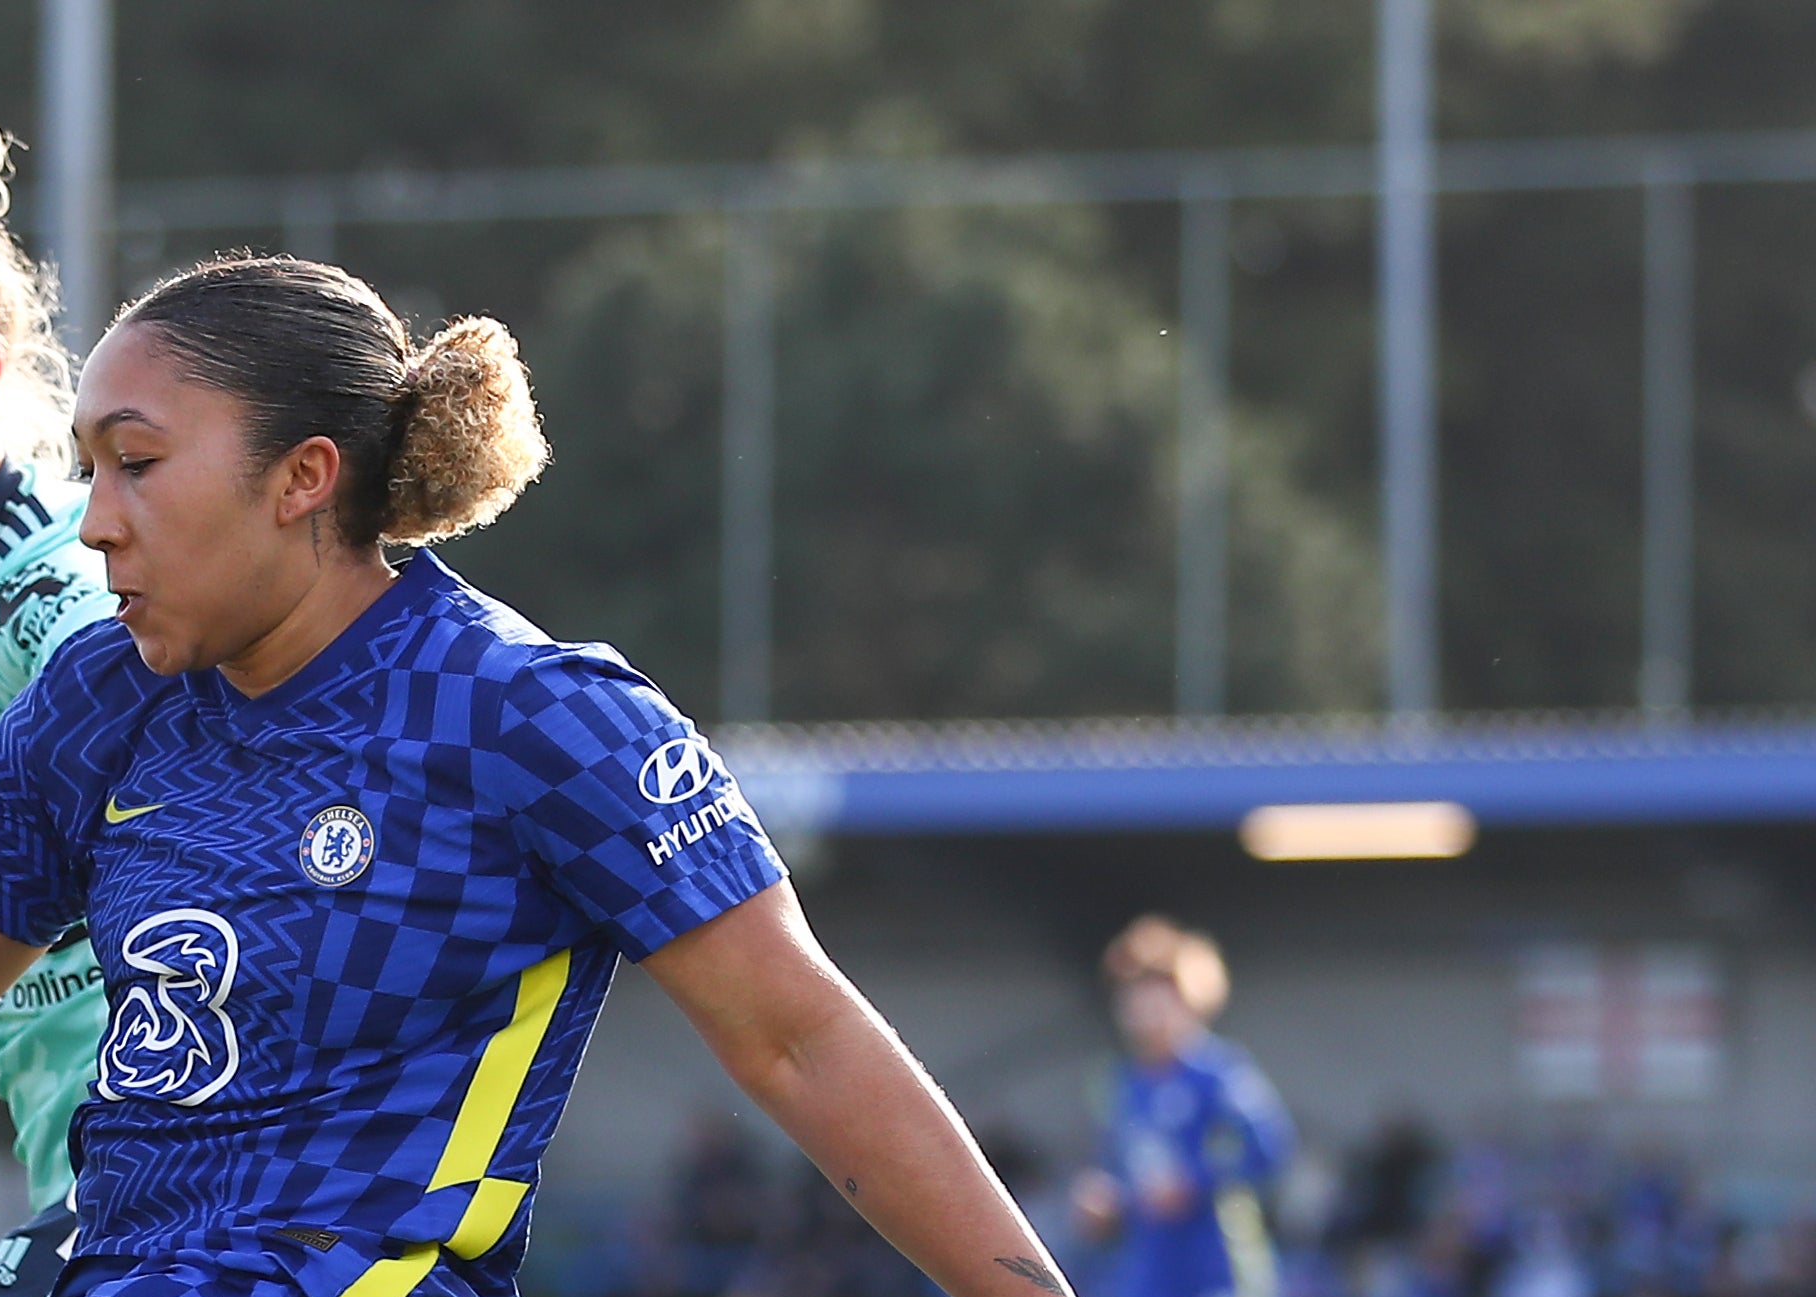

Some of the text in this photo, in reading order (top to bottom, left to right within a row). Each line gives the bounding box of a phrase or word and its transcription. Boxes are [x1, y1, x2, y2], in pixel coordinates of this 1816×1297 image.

[318, 809, 366, 831] CHELSEA
[646, 786, 744, 867] HYUNDA
[13, 966, 104, 1009] online
